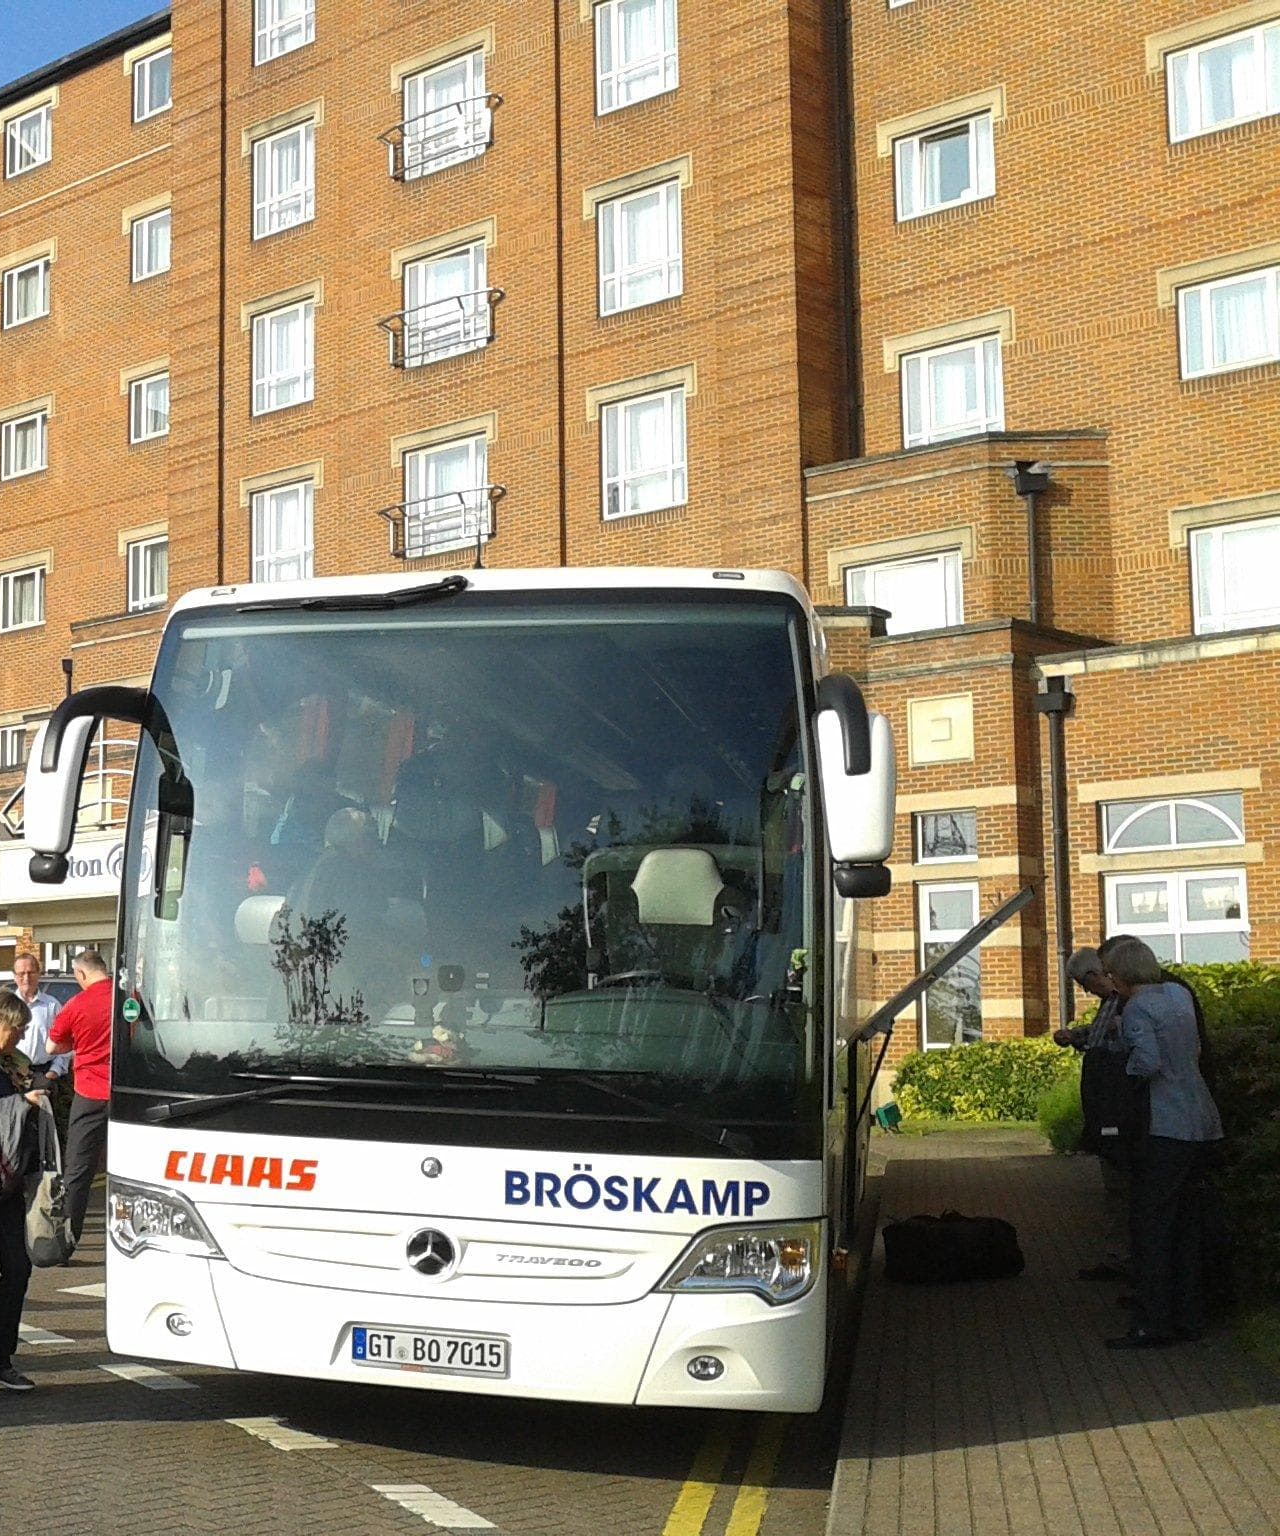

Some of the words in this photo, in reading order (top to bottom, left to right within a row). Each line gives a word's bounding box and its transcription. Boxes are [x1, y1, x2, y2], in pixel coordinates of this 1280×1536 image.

[69, 855, 103, 878] ton
[164, 1150, 319, 1191] CLAAS
[504, 1163, 770, 1216] BRÖSKAMP
[369, 1334, 396, 1358] GT
[413, 1338, 441, 1362] BO
[446, 1340, 502, 1367] 7015
